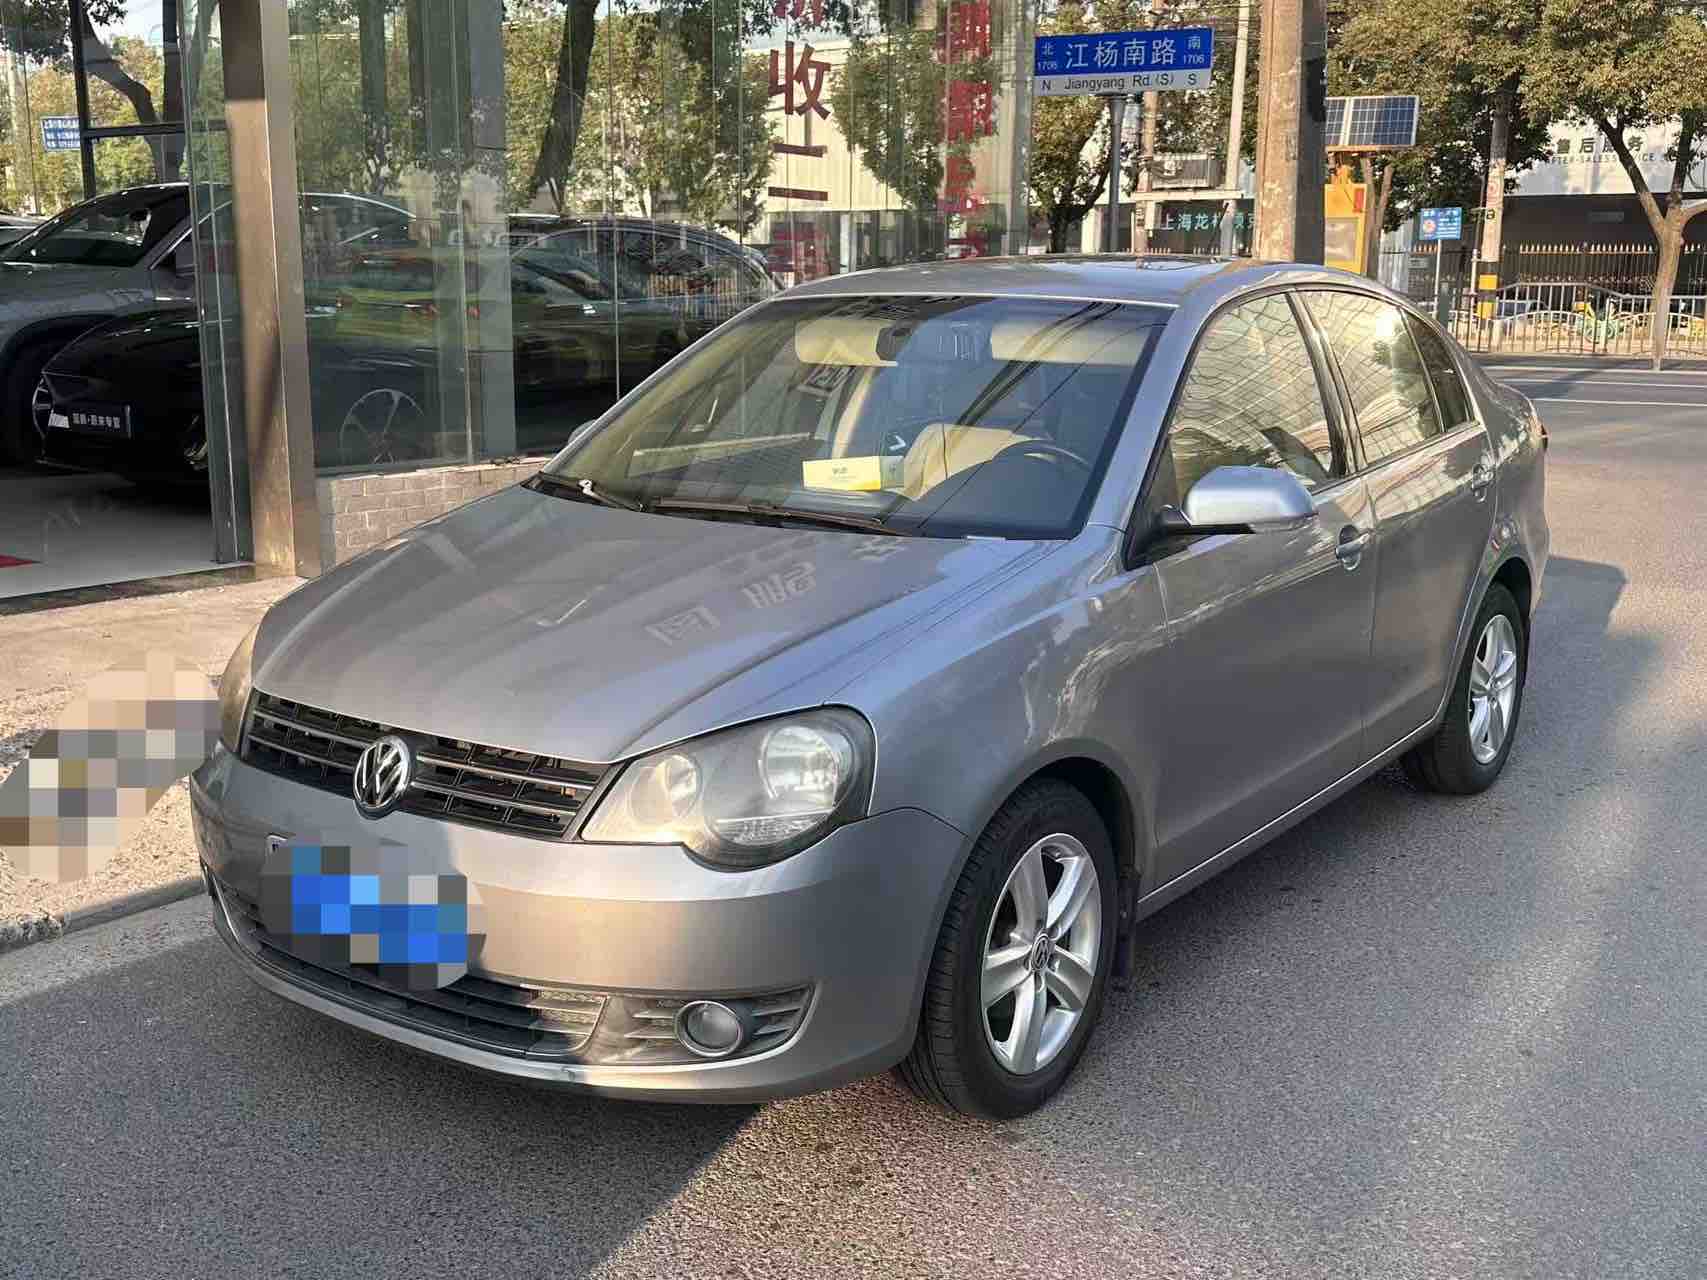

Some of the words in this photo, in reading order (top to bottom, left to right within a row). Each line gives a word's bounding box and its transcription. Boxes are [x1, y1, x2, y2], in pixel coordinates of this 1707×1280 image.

[1042, 43, 1054, 56] 北
[1065, 36, 1176, 69] 江杨南路
[1187, 35, 1201, 49] 南
[1183, 54, 1205, 64] 1706
[1042, 81, 1051, 91] N
[1065, 77, 1125, 92] Jiangyang
[1133, 75, 1150, 86] Rd
[1155, 74, 1174, 86] (S)
[1187, 73, 1198, 85] S
